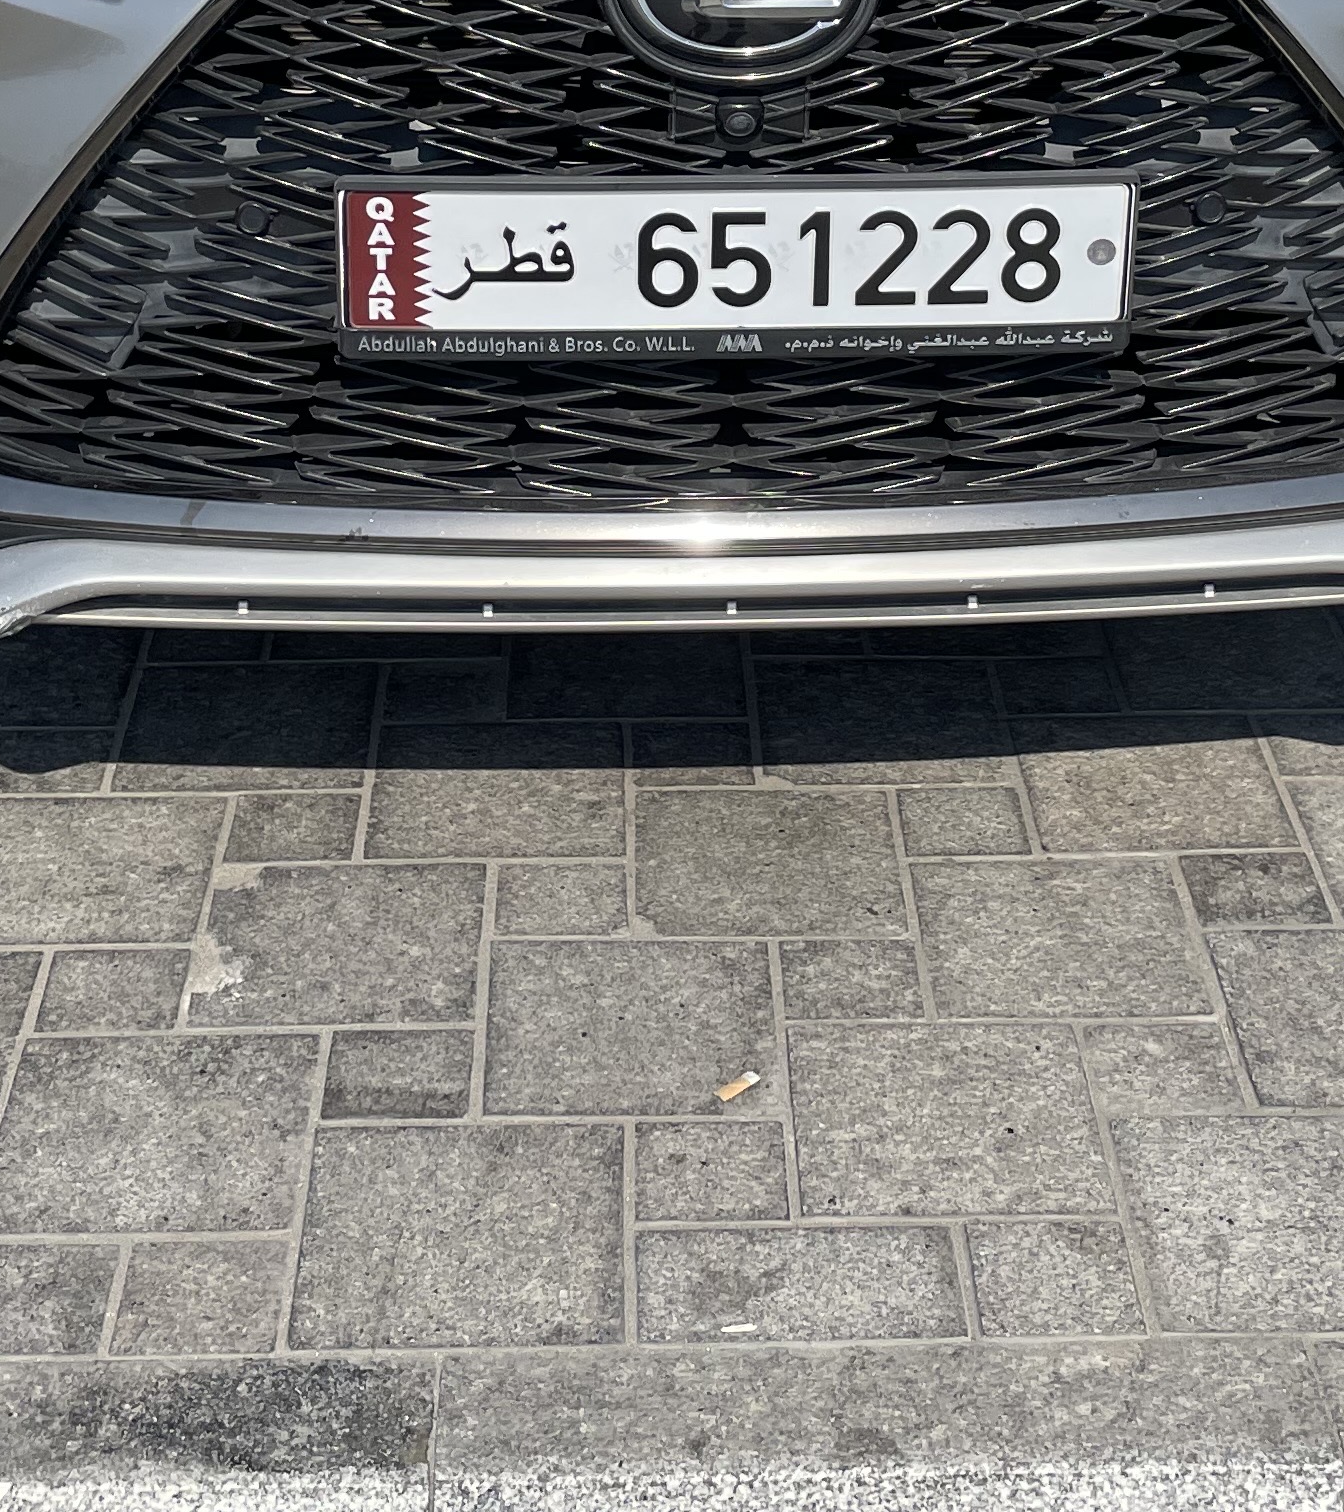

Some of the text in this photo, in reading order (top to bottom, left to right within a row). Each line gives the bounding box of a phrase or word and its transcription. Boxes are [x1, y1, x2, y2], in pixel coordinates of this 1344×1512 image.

[365, 196, 396, 321] QATAR
[432, 222, 575, 301] قطر
[636, 208, 1062, 308] 651228
[357, 335, 696, 356] Abdullah Abdulghani & Bros. Co. W.L.L.
[907, 334, 989, 355] عبدالغني
[995, 327, 1055, 347] عبدالله
[1061, 329, 1114, 346] شركة
